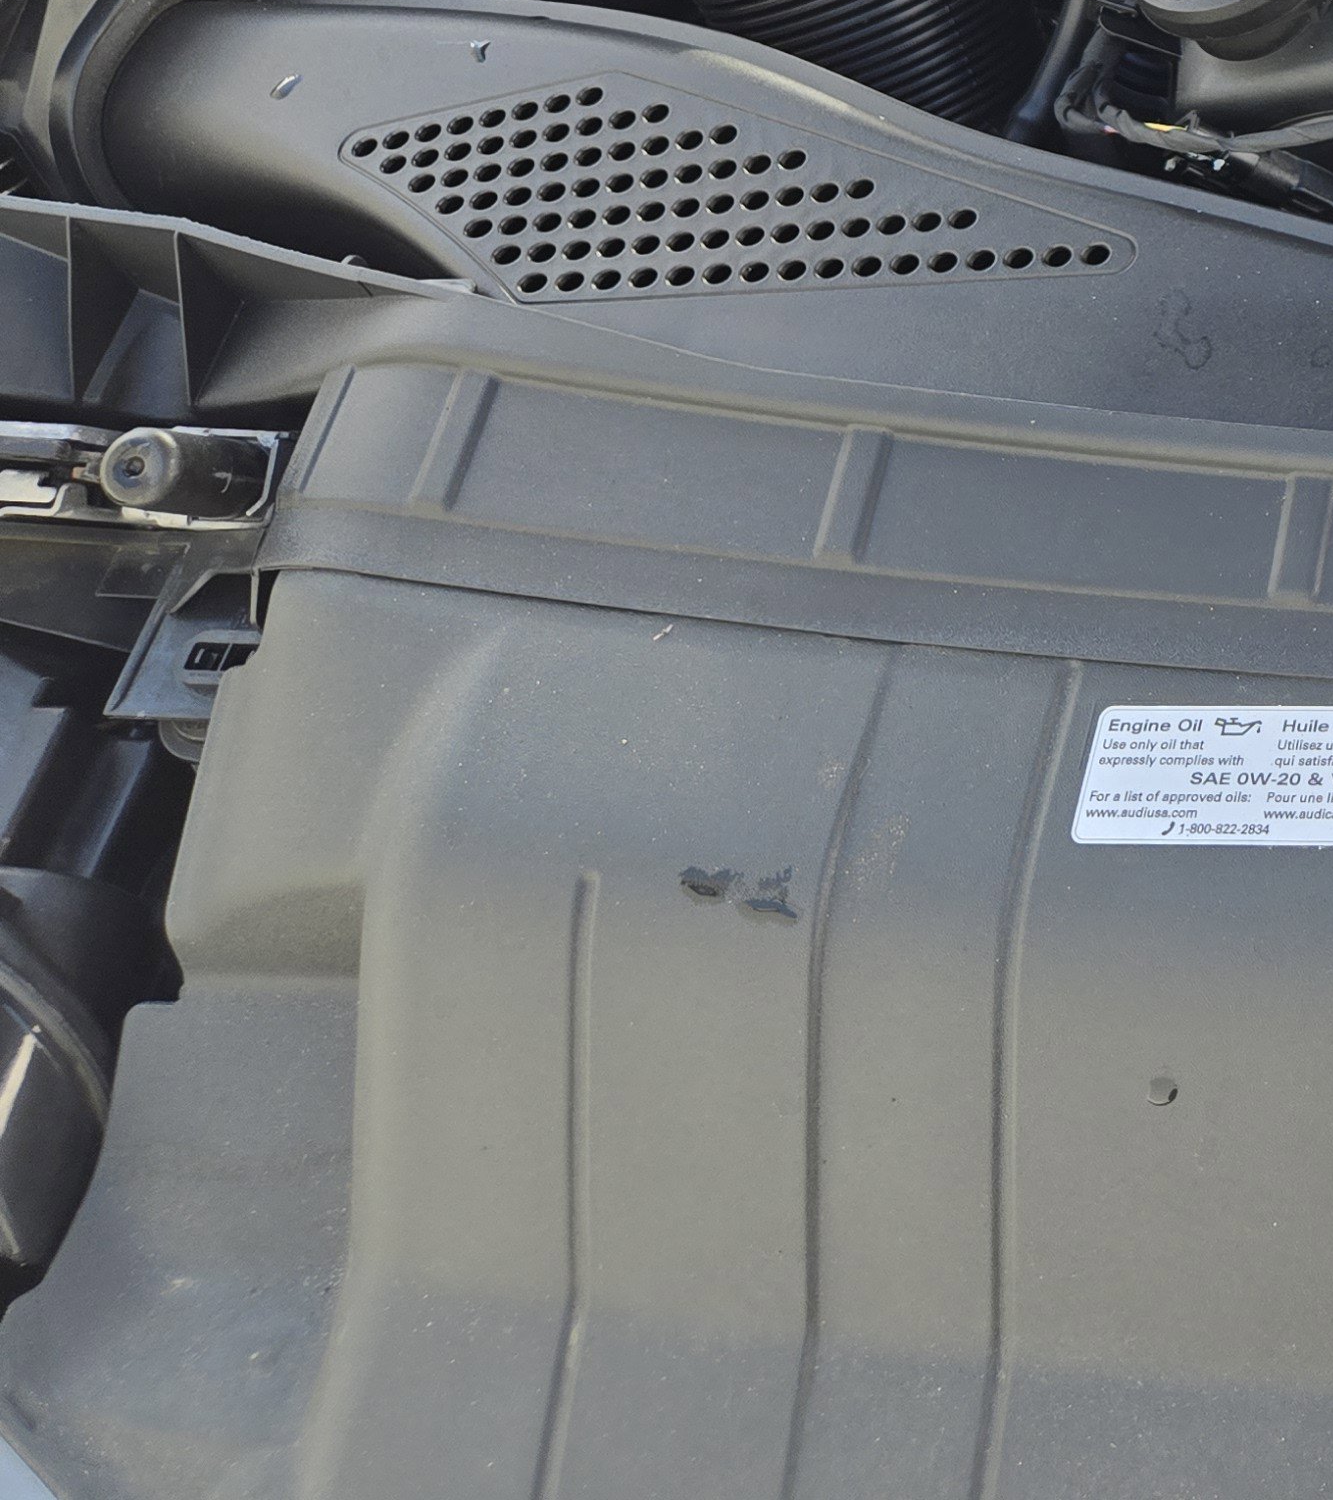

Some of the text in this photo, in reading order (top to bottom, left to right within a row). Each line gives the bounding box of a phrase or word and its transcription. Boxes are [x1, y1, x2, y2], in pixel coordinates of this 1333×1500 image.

[1108, 719, 1203, 735] Engine Oil
[1282, 719, 1329, 733] Huile
[1103, 739, 1204, 751] Use only oil that
[1277, 739, 1322, 751] Utilisez
[1099, 755, 1244, 767] expressly complies with
[1274, 757, 1295, 768] qui
[1190, 772, 1231, 785] SAE
[1237, 773, 1301, 786] 0W-20
[1307, 774, 1323, 786] &
[1090, 791, 1251, 804] For a list of approved oils:
[1267, 792, 1296, 804] Pour
[1300, 795, 1323, 804] une
[1086, 807, 1198, 819] www.audiusa.com
[1179, 824, 1269, 835] 1-800-822-2834
